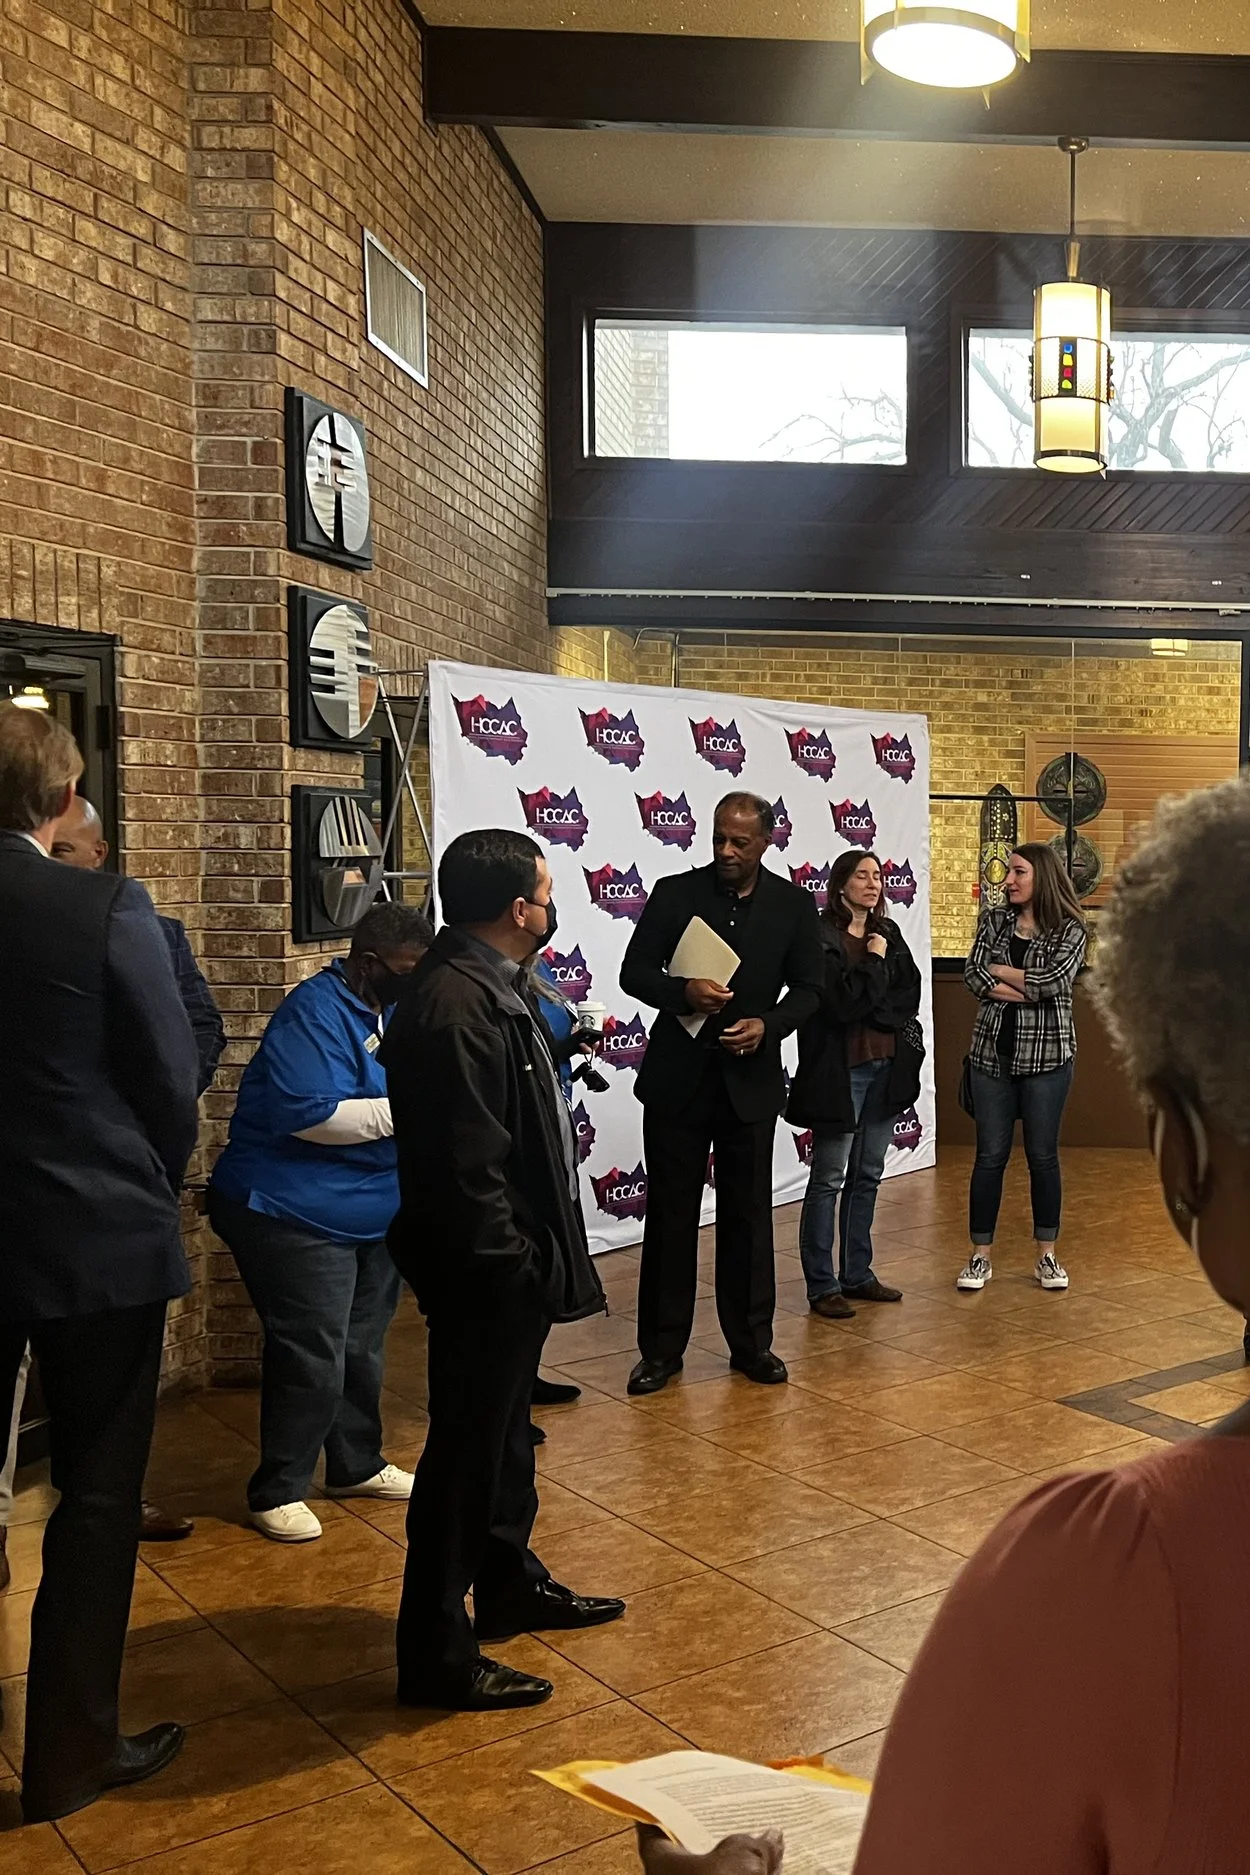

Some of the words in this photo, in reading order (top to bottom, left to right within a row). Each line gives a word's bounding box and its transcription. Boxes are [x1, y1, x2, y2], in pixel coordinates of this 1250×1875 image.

[471, 716, 518, 736] HCCAC
[595, 727, 636, 744] HCCAC
[703, 735, 739, 752] HCCAC
[536, 807, 580, 823] HCCAC
[650, 810, 688, 826] HCCAC
[600, 883, 640, 899] HCCAC
[551, 965, 583, 982] CAC
[893, 1119, 917, 1135] CCAC
